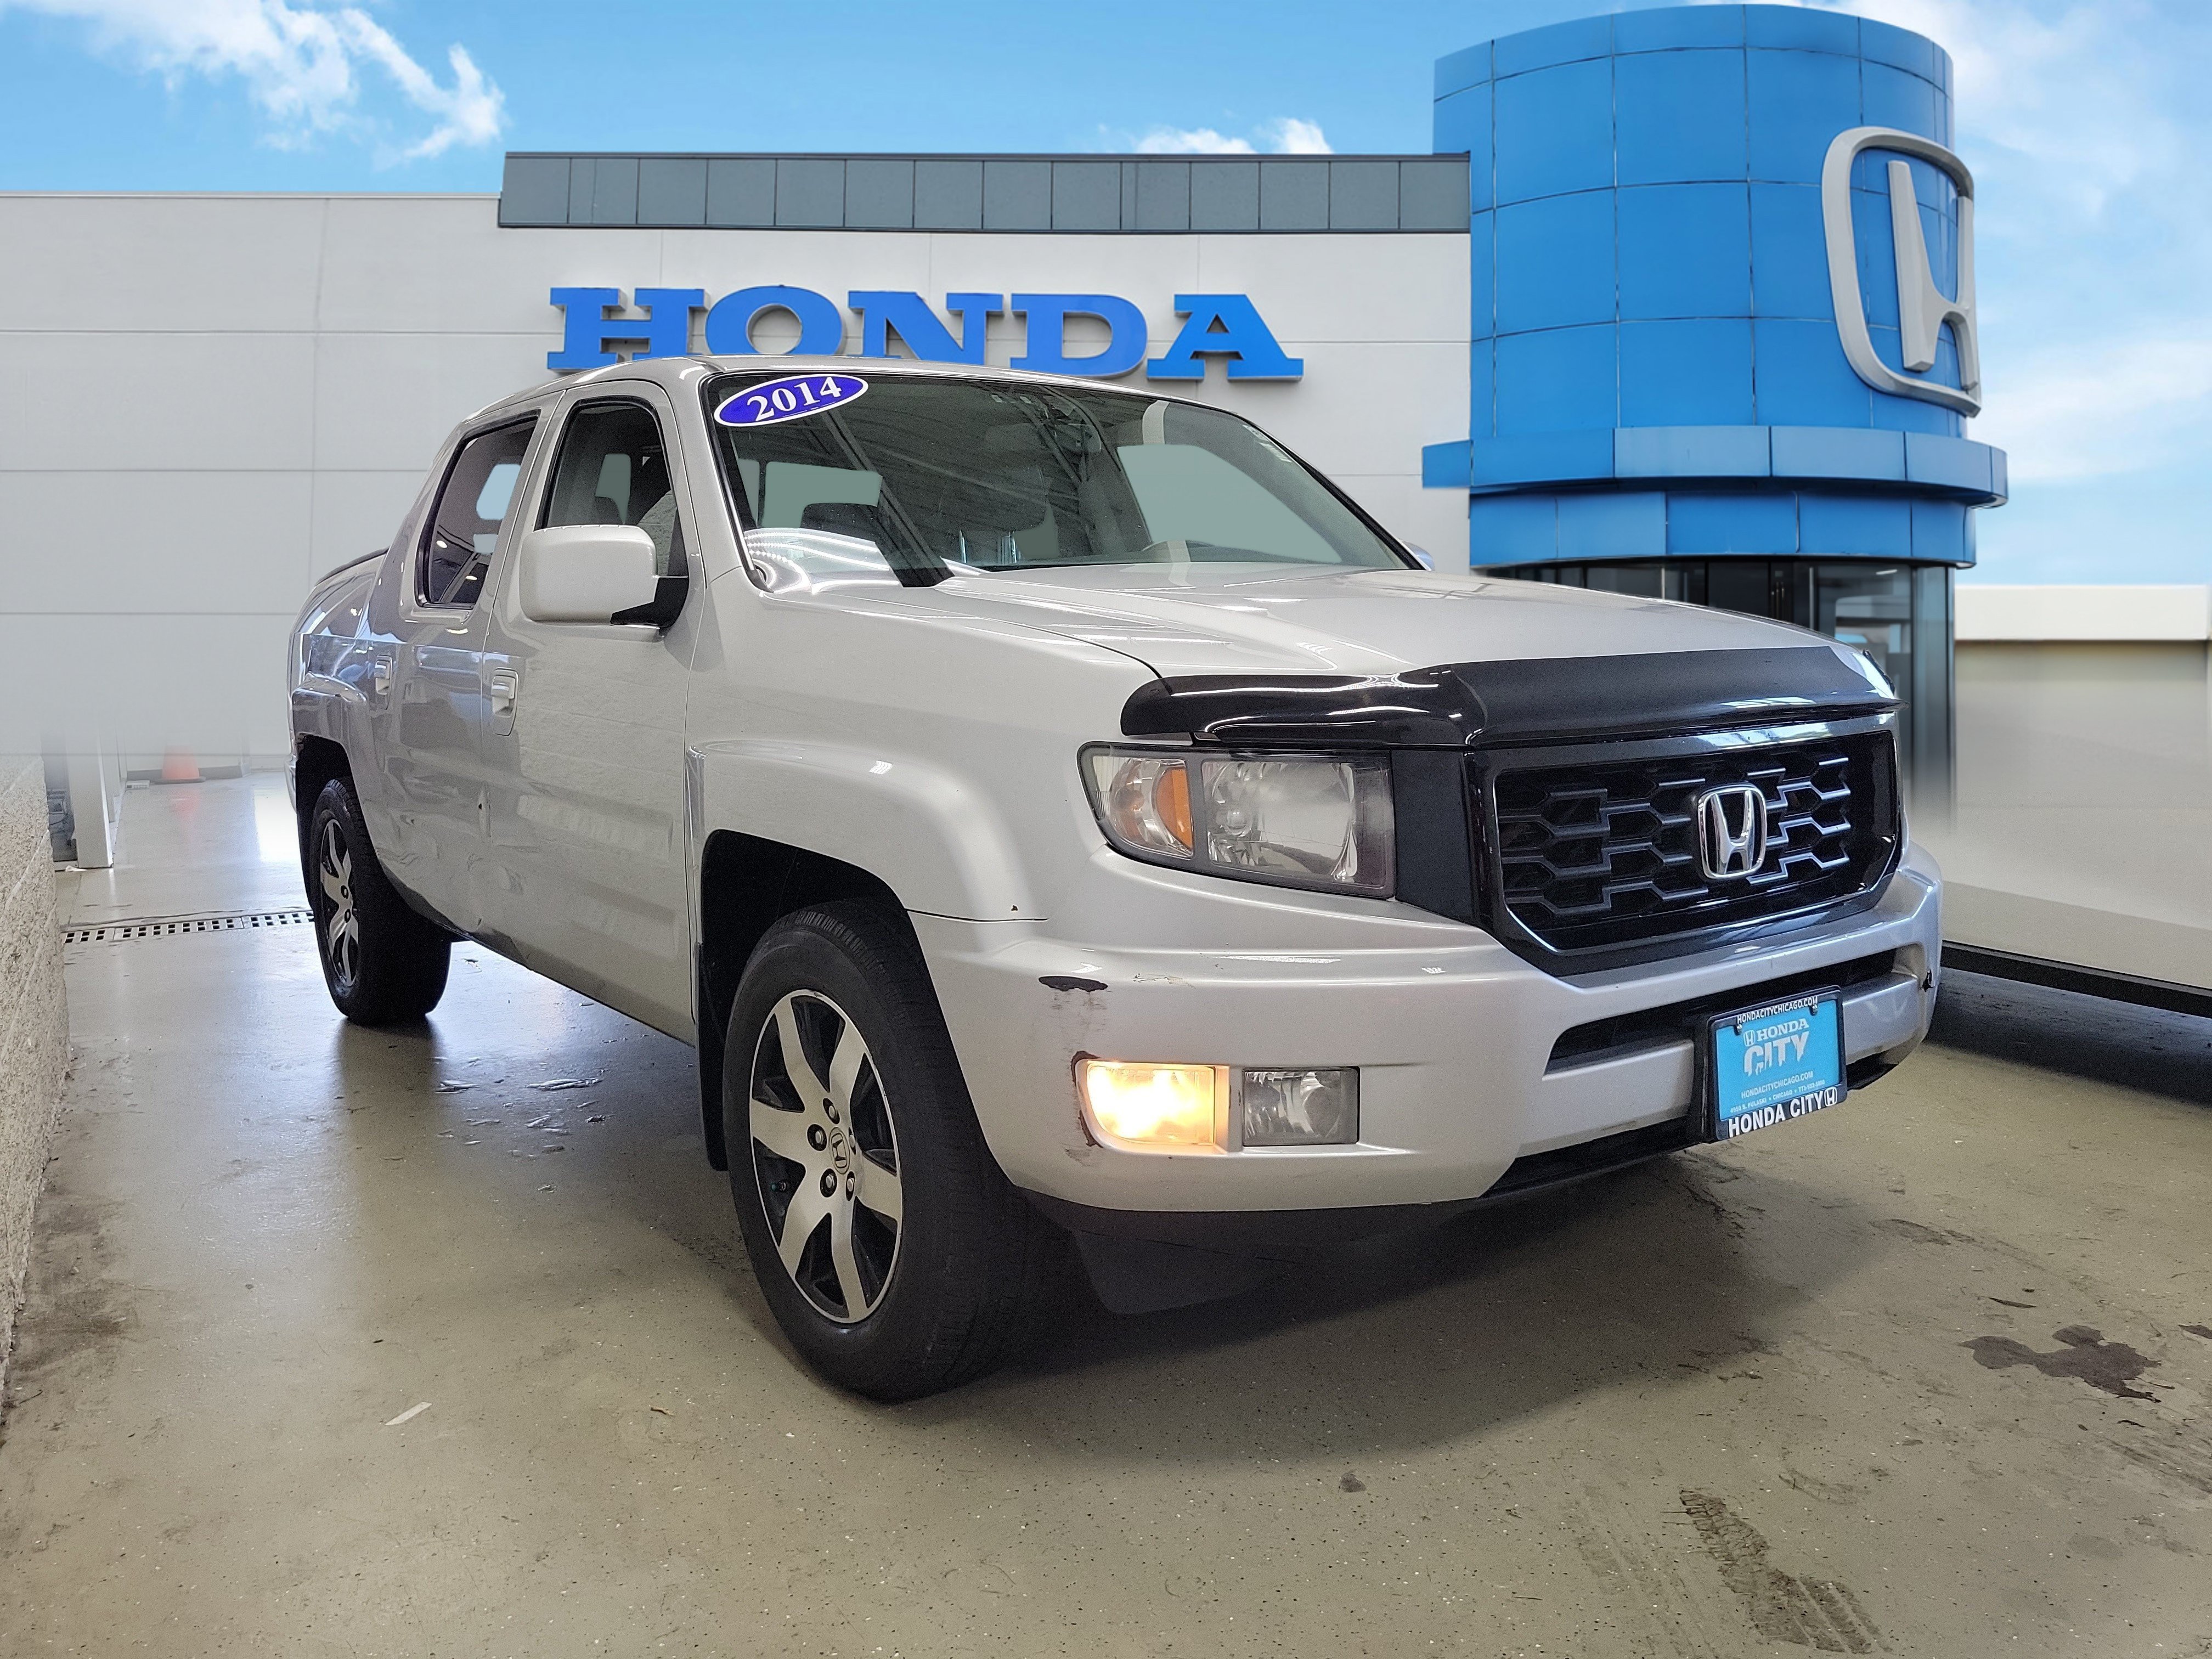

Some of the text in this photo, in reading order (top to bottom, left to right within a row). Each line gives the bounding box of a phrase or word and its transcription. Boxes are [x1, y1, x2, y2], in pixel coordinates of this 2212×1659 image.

[547, 285, 1304, 382] HONDA
[747, 377, 842, 421] 2014
[1737, 996, 1818, 1024] HONDACITYCHICAGO.COM
[1756, 1018, 1810, 1042] HONDA
[1744, 1031, 1810, 1076] CITY
[1741, 1070, 1814, 1099] HONDACITYCHICAGO.COM
[1728, 1103, 1786, 1138] HONDA
[1790, 1090, 1824, 1118] CITY
